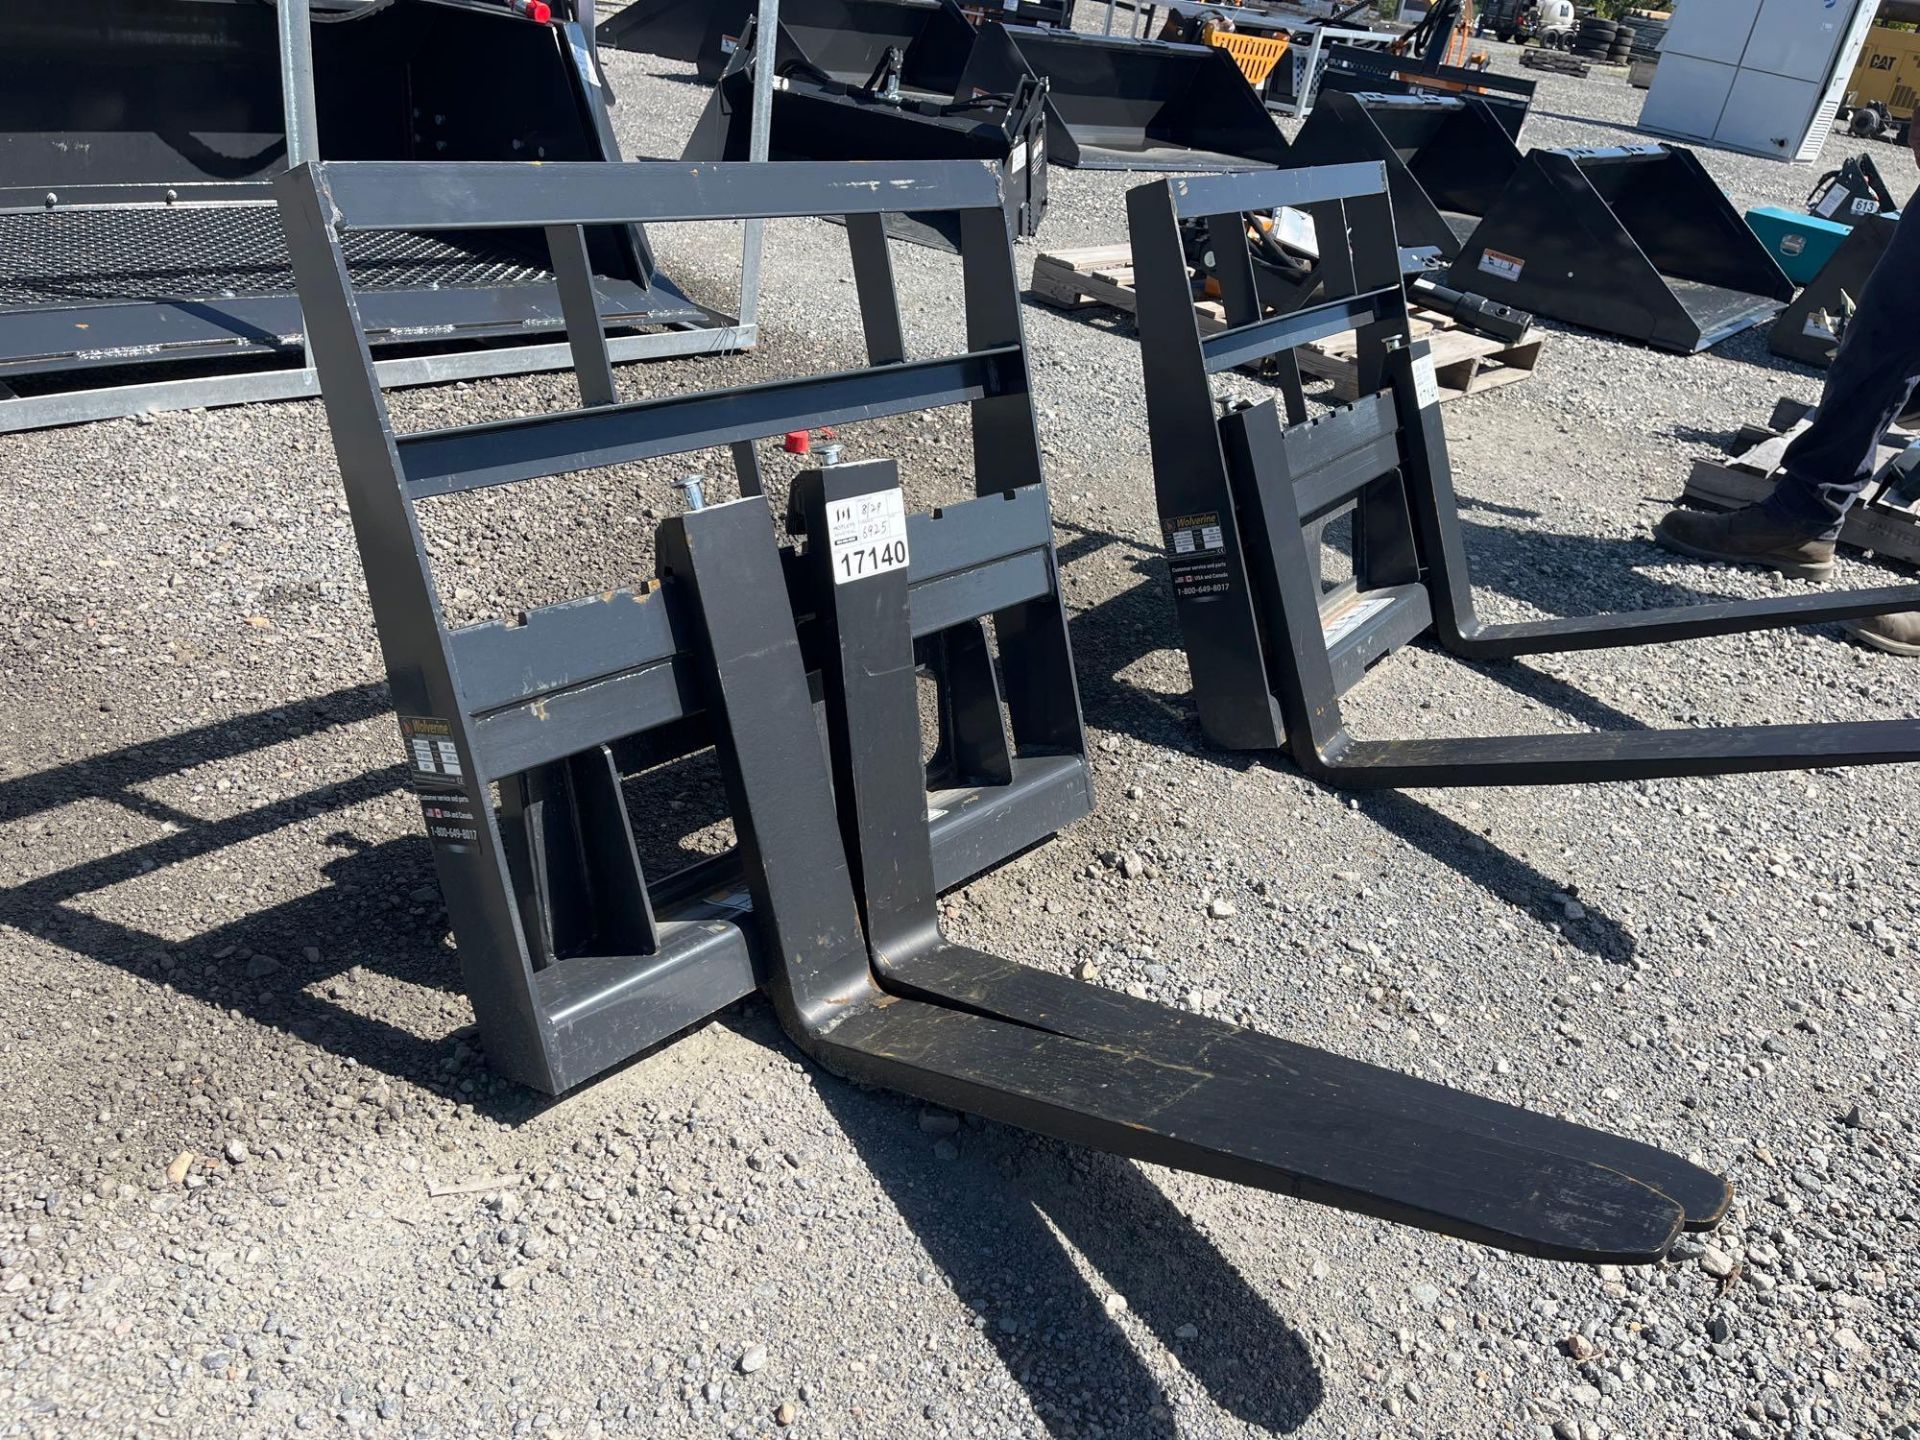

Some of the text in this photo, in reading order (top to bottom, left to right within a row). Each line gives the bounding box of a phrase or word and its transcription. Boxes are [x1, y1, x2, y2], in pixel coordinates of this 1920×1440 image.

[1870, 54, 1897, 70] CAT
[1855, 200, 1875, 212] 613
[1177, 515, 1216, 527] Wolverine
[841, 540, 906, 576] 17140
[1178, 584, 1229, 595] 1-800-649-8017
[412, 719, 449, 735] Wolverine
[443, 810, 473, 820] USA and Canada
[431, 826, 477, 841] 1-800-649-8017
